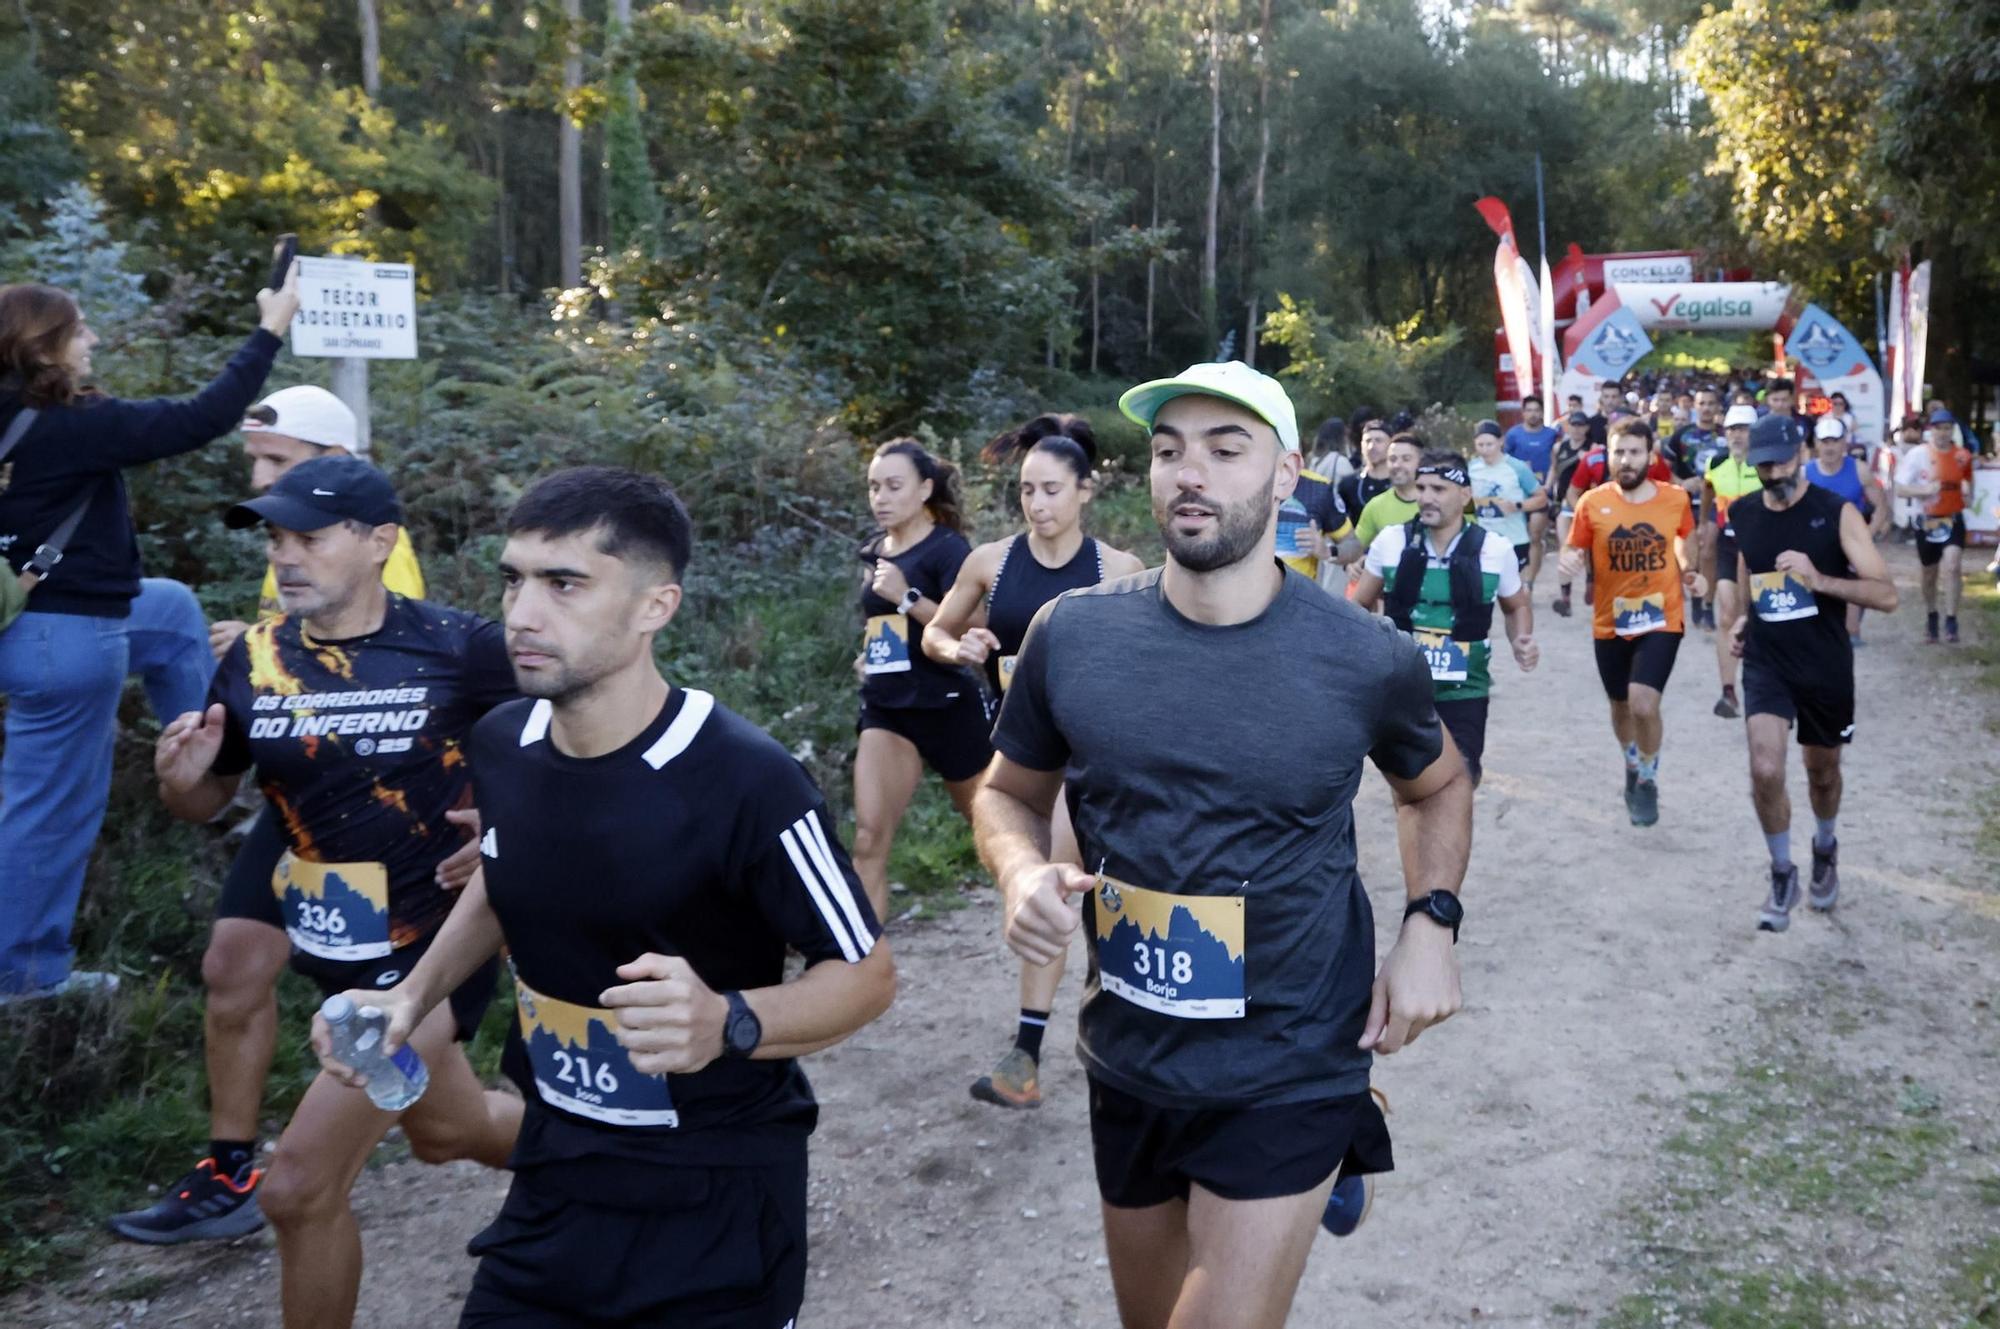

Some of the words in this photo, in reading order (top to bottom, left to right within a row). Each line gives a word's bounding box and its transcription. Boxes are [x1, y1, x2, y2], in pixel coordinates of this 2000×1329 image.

[1611, 265, 1685, 279] CONCELLO
[321, 289, 379, 307] TECOR
[1651, 293, 1752, 322] Vegalsa
[297, 309, 407, 329] SOCIETARIO
[252, 695, 283, 711] OS
[281, 687, 428, 709] CORREDORES
[249, 717, 290, 738] DO
[289, 709, 429, 738] INFERNO
[376, 737, 414, 753] 25
[297, 901, 346, 934] 336
[1133, 942, 1193, 984] 318
[1146, 979, 1177, 998] Borja
[552, 1050, 618, 1093] 216
